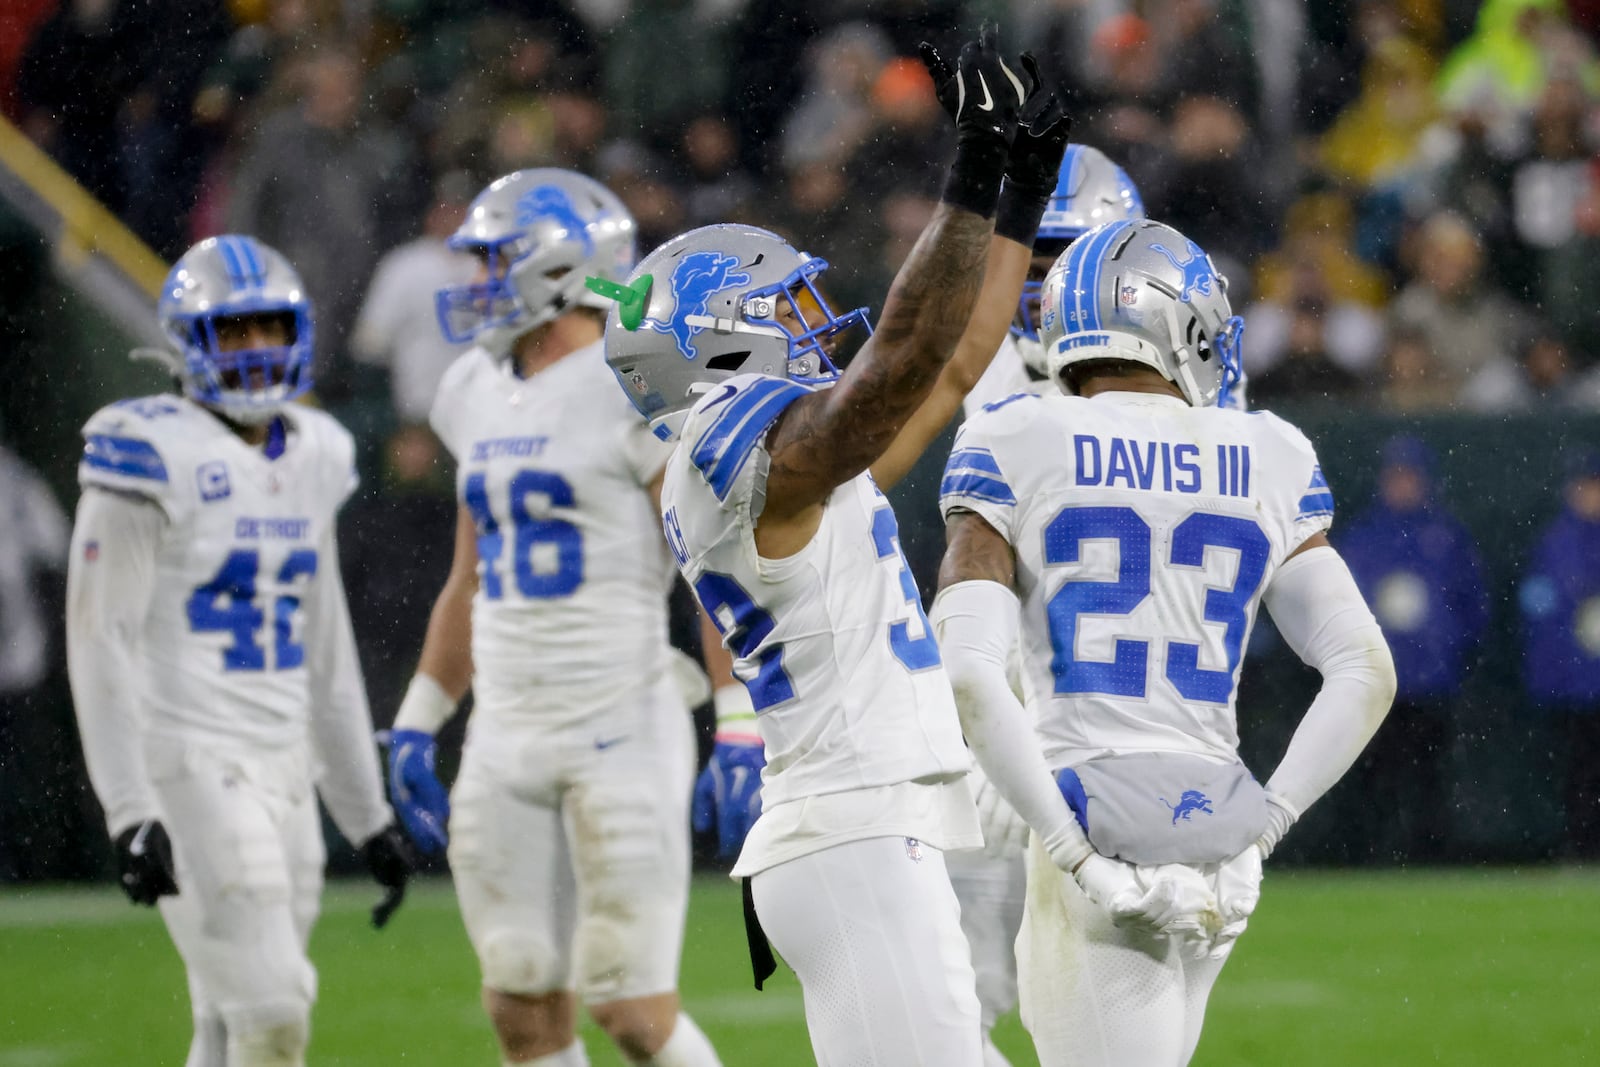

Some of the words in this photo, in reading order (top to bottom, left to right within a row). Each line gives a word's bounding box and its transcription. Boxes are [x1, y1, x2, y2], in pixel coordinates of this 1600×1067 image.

[470, 435, 550, 461] DETROIT
[1073, 434, 1202, 494] DAVIS
[1217, 444, 1250, 498] III
[235, 516, 310, 539] DETROIT
[1043, 503, 1273, 707] 23
